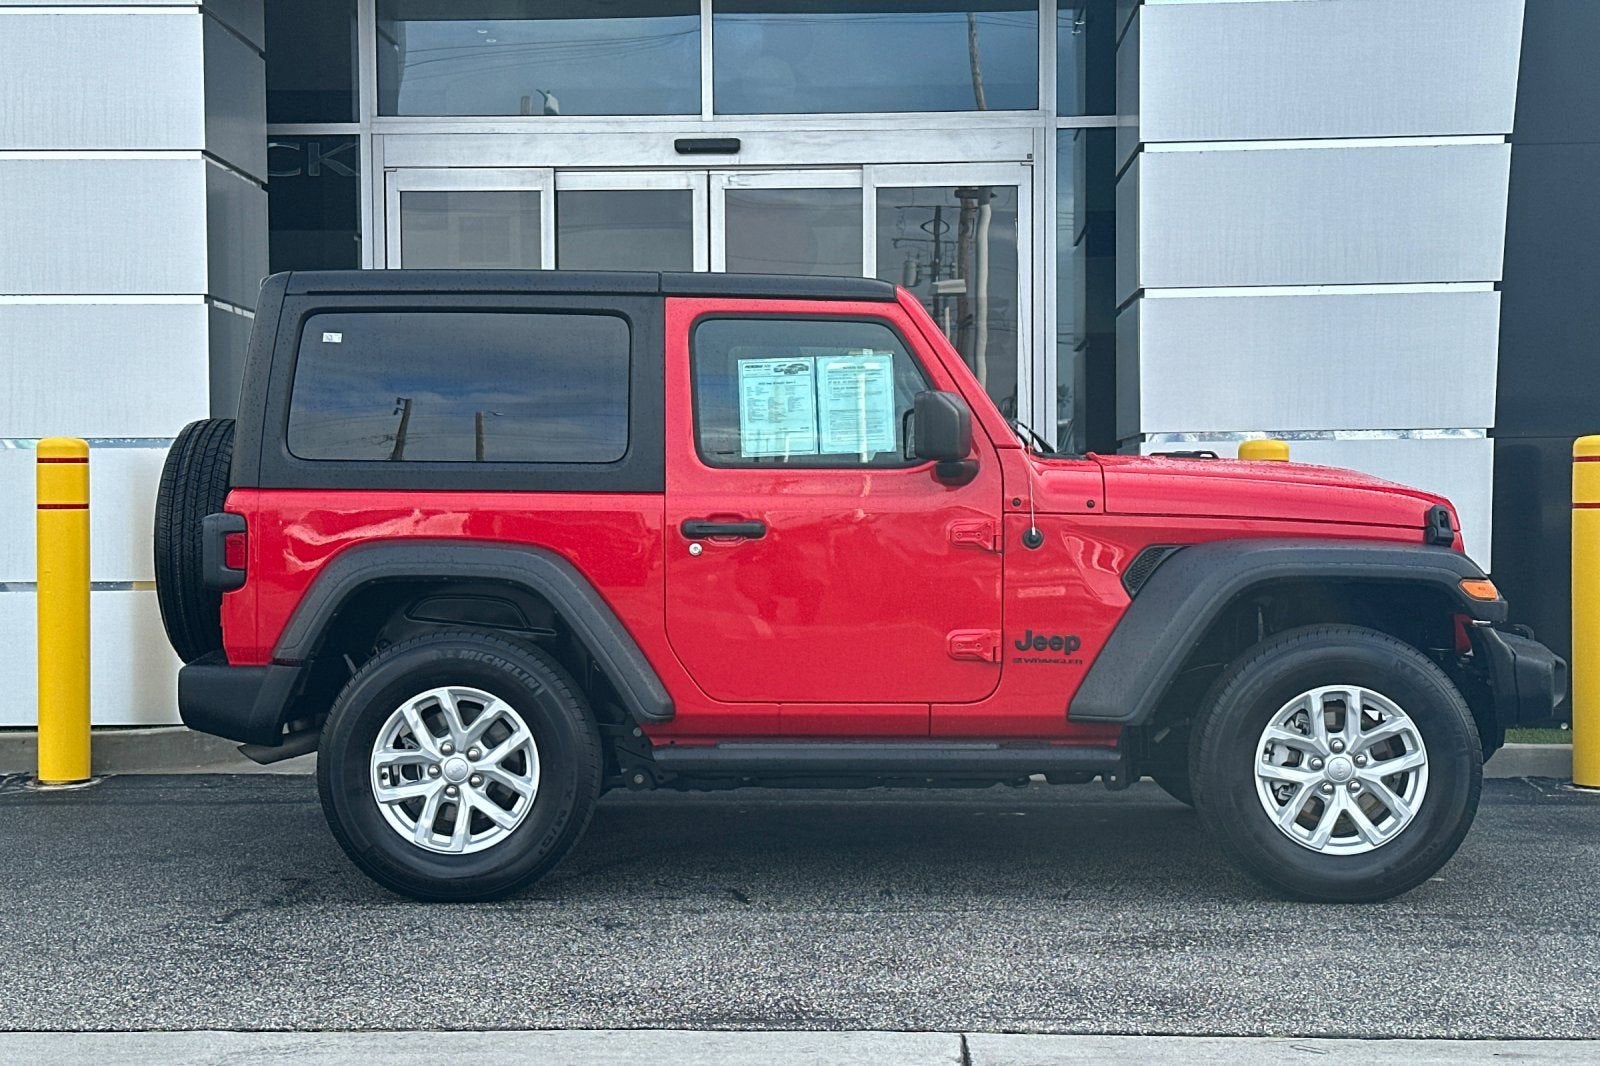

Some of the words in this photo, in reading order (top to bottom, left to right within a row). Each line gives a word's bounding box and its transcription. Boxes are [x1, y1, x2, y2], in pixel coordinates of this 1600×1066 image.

[1014, 629, 1081, 655] Jeep
[458, 649, 542, 690] MICHELIN
[1023, 657, 1083, 665] WRANGLER
